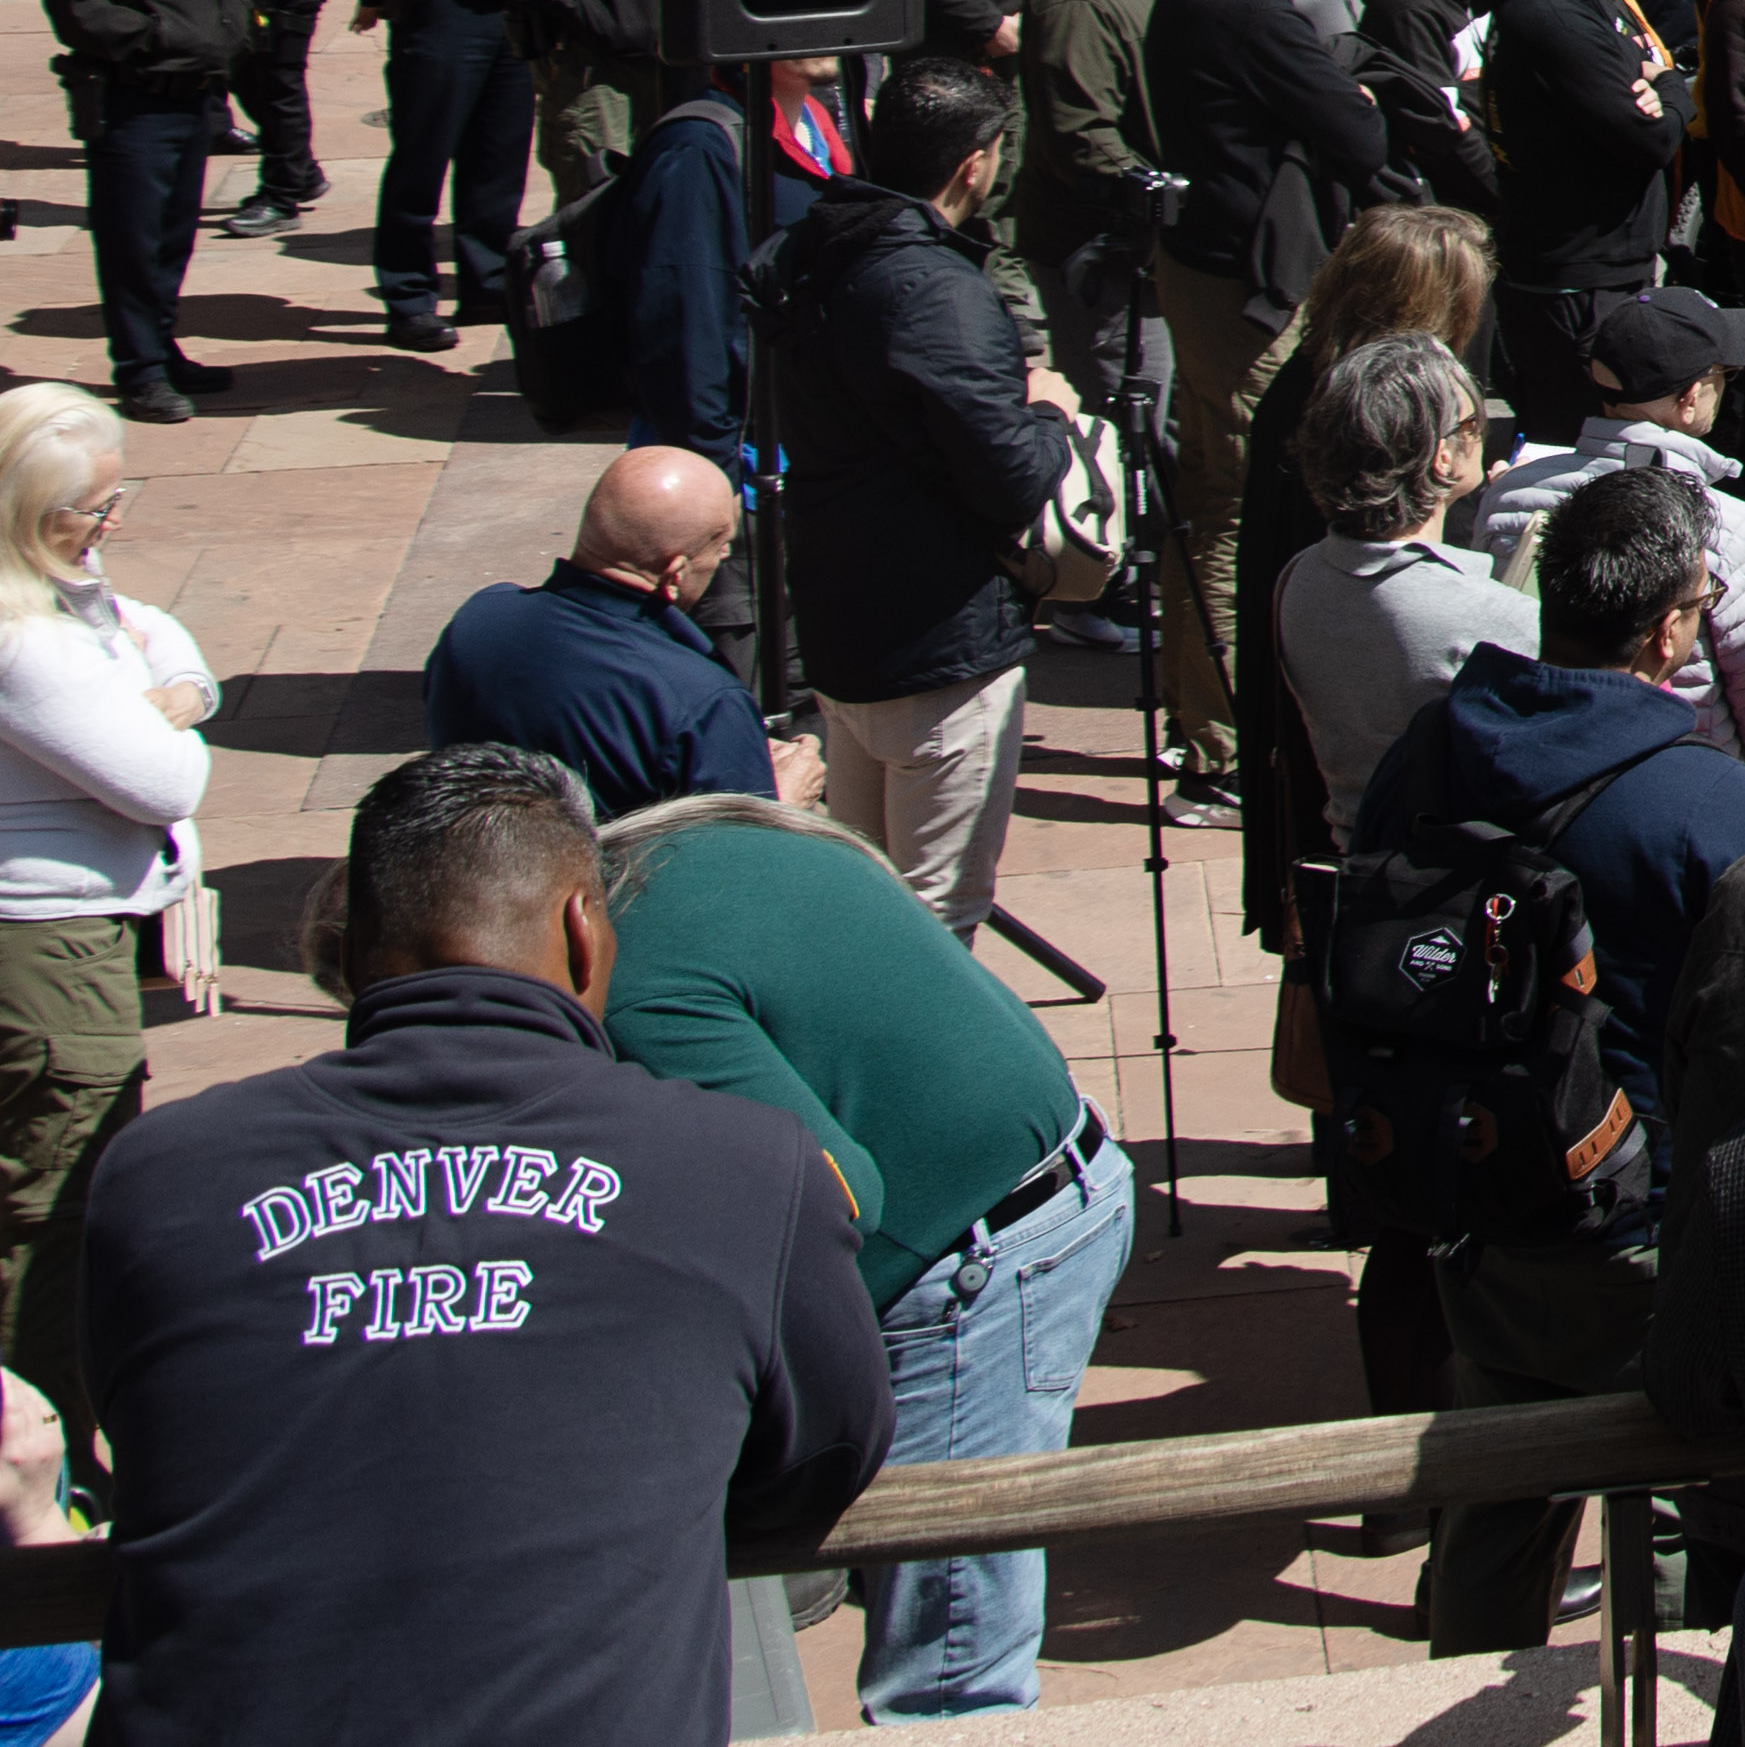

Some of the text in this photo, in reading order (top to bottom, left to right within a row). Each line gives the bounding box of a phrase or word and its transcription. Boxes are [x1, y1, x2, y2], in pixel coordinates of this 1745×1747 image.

[1412, 944, 1457, 964] Wilder
[240, 1145, 623, 1263] DENVER
[303, 1260, 534, 1346] FIRE
